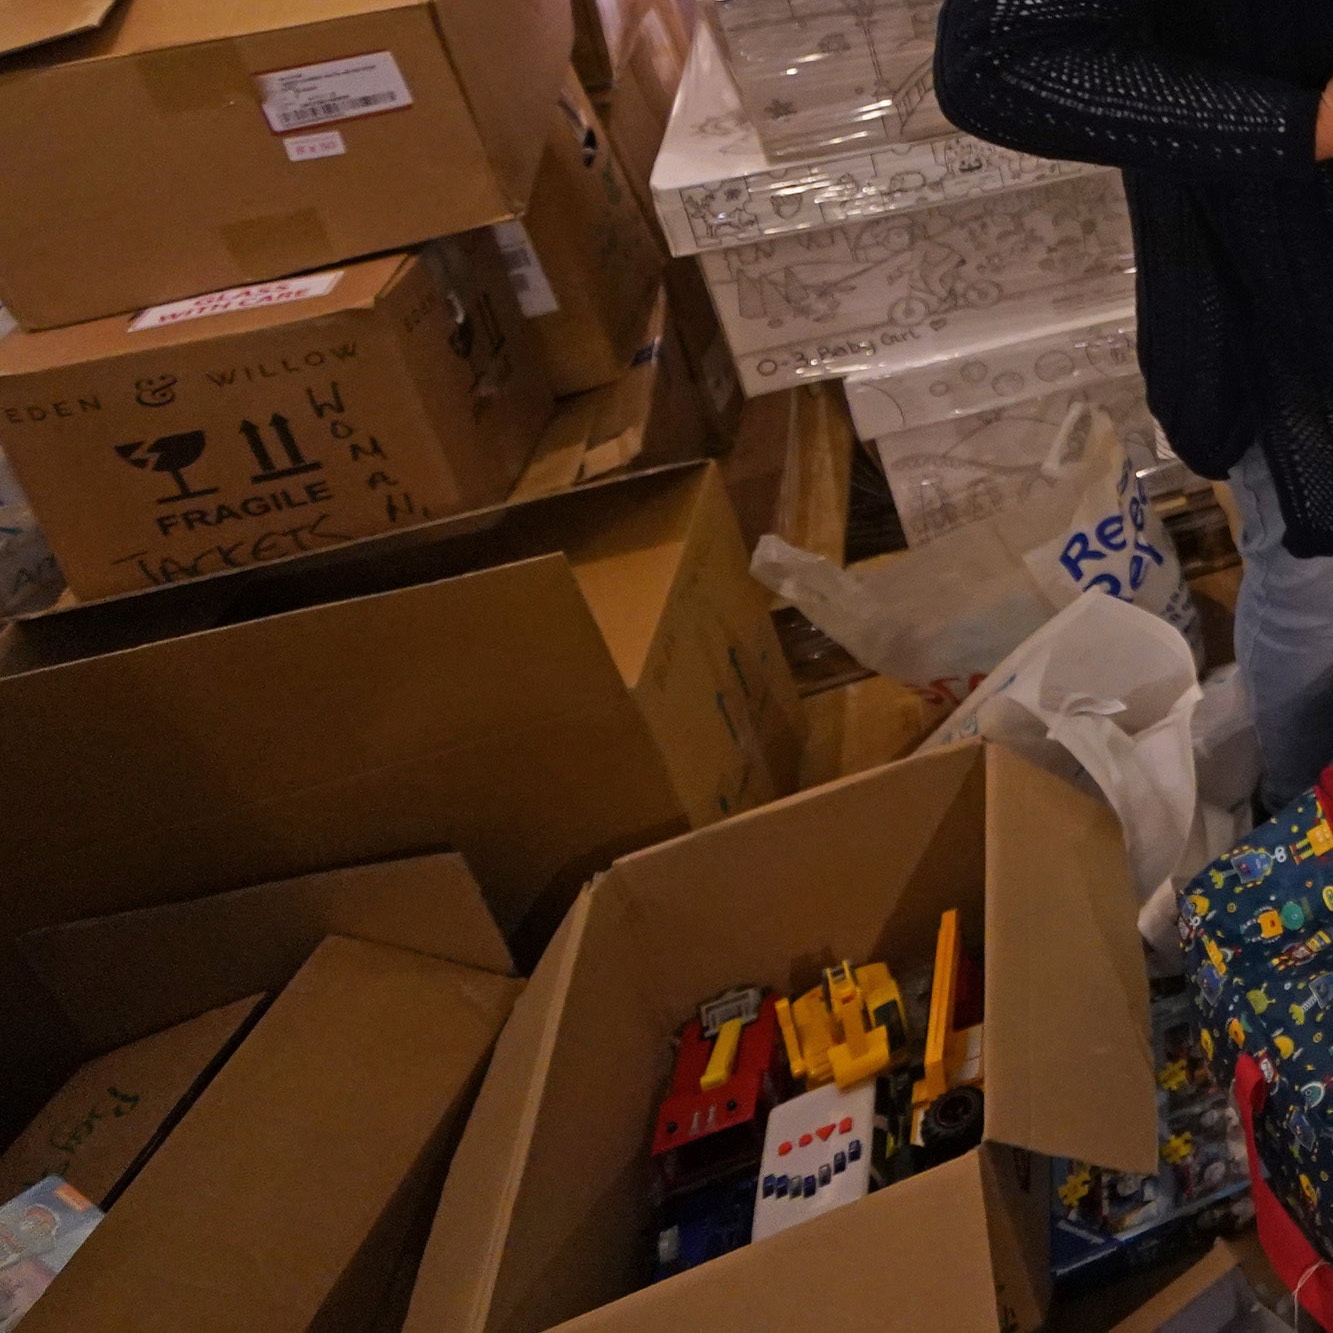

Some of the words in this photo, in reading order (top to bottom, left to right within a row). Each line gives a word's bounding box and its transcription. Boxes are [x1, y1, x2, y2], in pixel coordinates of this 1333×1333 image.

[158, 299, 231, 325] WITH
[239, 288, 310, 310] CARE
[193, 282, 290, 308] GLASS
[5, 397, 103, 425] EDEN
[135, 372, 179, 409] &
[207, 342, 359, 388] WILLOW
[155, 481, 334, 536] FRAGILE
